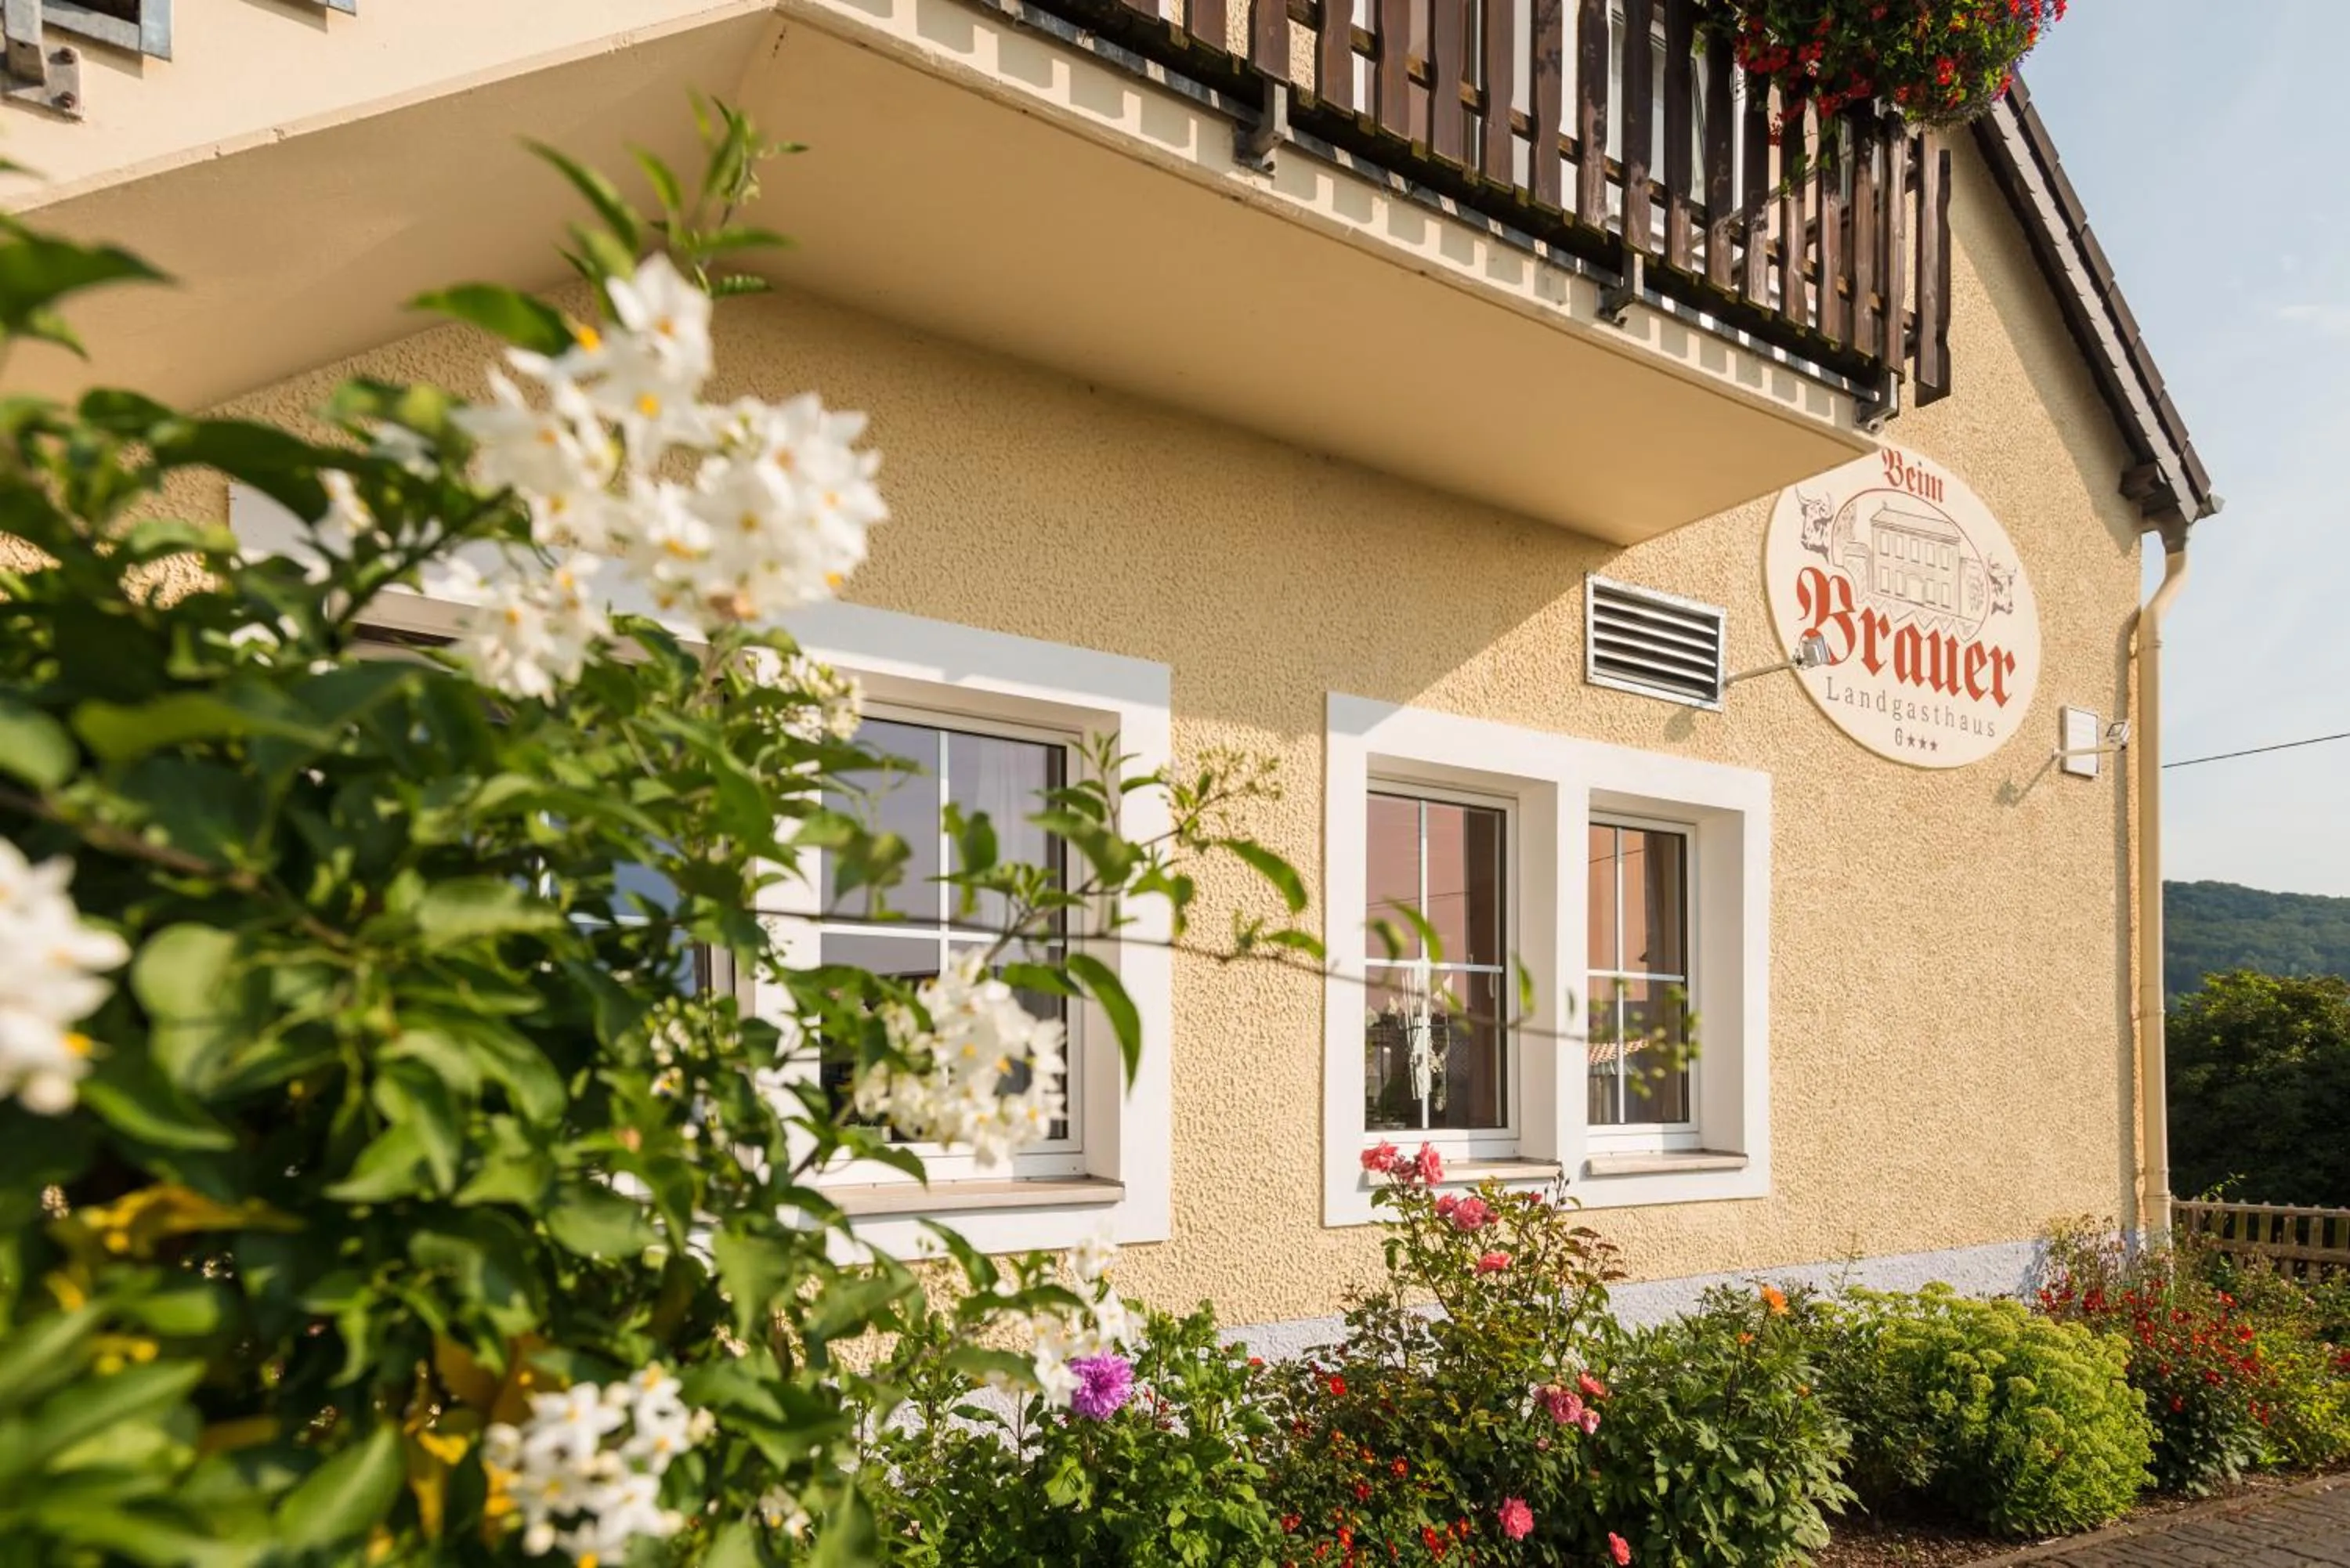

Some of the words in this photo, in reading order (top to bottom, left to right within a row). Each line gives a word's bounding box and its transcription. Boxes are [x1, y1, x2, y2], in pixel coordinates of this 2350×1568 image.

[1881, 447, 1943, 503] Beim
[1797, 566, 2016, 707] Brauer
[1826, 676, 1995, 737] Landgasthaus
